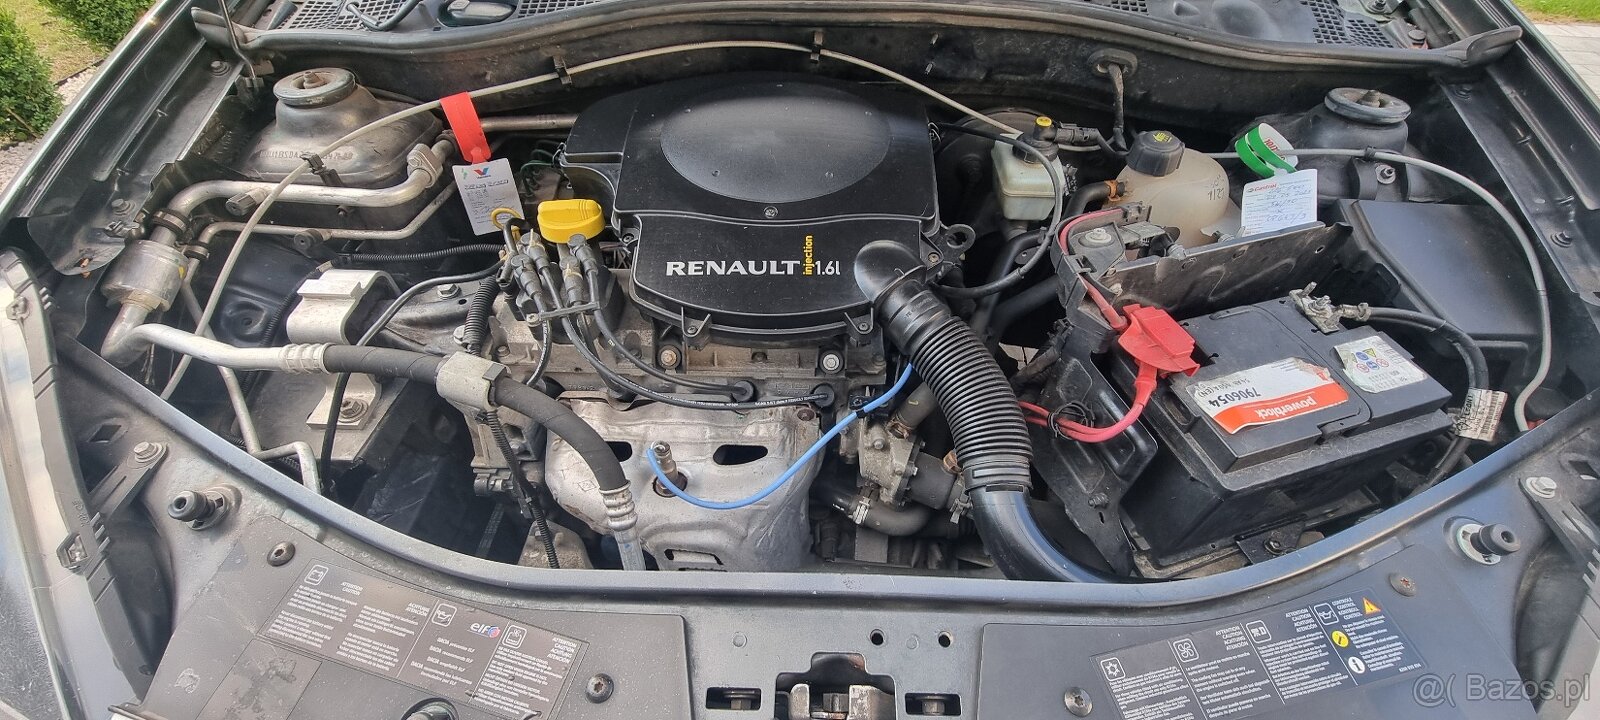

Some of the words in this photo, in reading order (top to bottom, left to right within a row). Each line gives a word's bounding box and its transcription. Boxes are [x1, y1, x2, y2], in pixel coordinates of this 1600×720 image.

[803, 235, 813, 276] injection
[666, 260, 800, 276] RENAULT
[1208, 386, 1262, 408] 7906054
[1254, 396, 1317, 419] powerblock
[470, 623, 491, 633] elf
